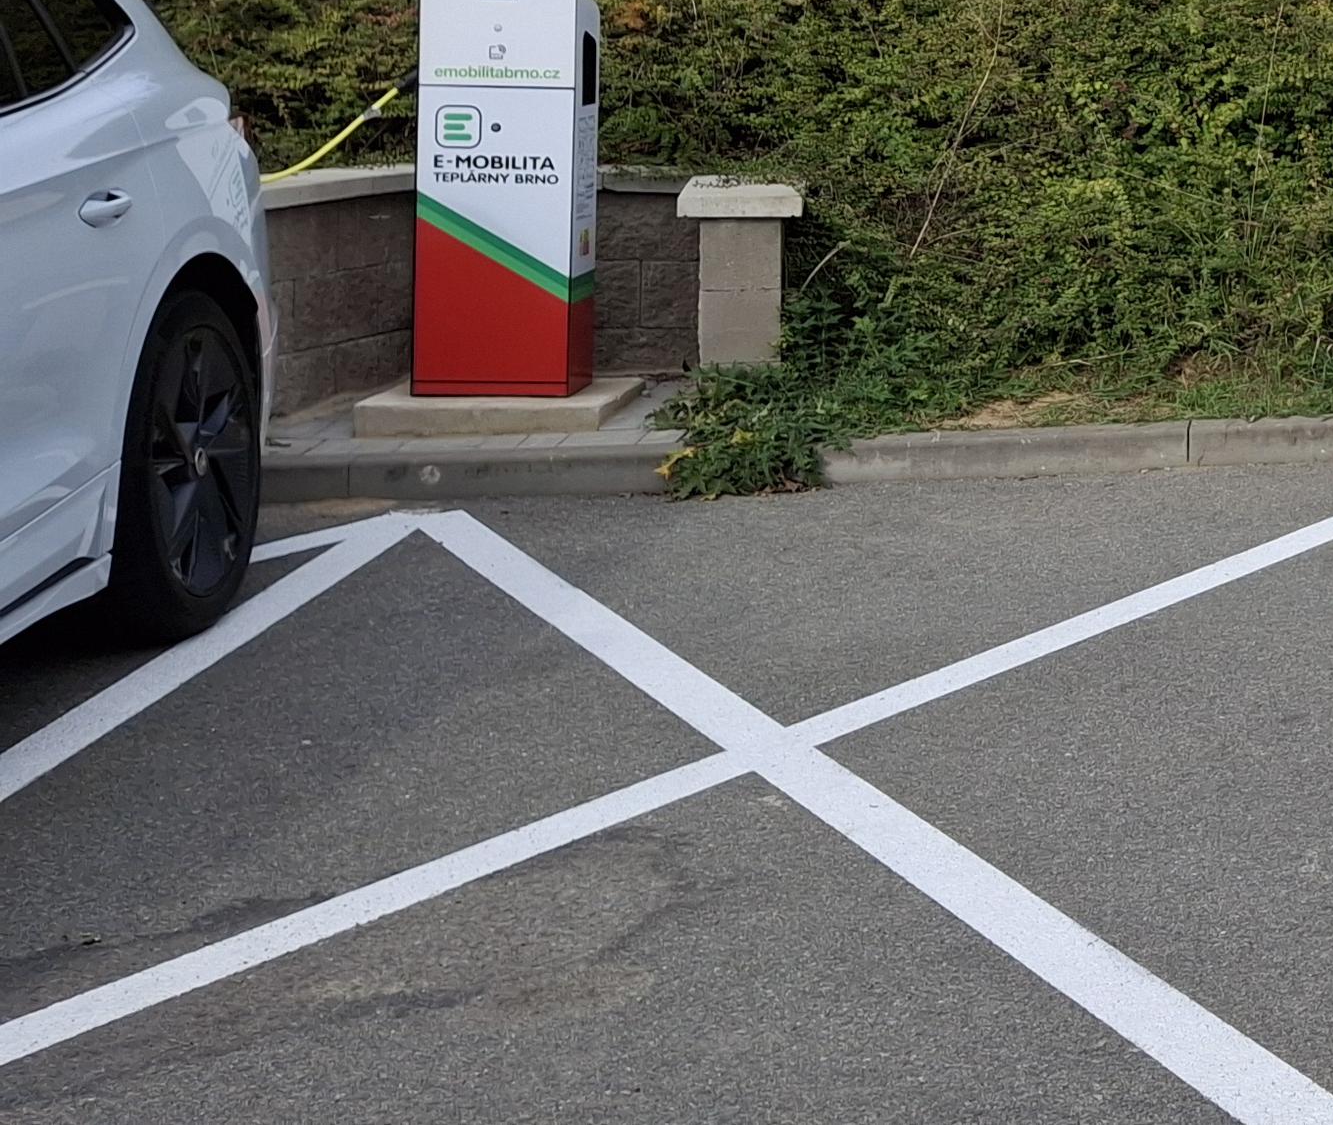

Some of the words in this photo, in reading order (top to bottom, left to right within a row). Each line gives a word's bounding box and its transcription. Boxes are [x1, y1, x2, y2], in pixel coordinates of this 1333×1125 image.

[434, 64, 561, 80] emobilitabrno.cz
[433, 154, 556, 171] E-MOBILITA
[433, 170, 510, 184] TEPLÁRNY
[514, 174, 560, 185] BRNO
